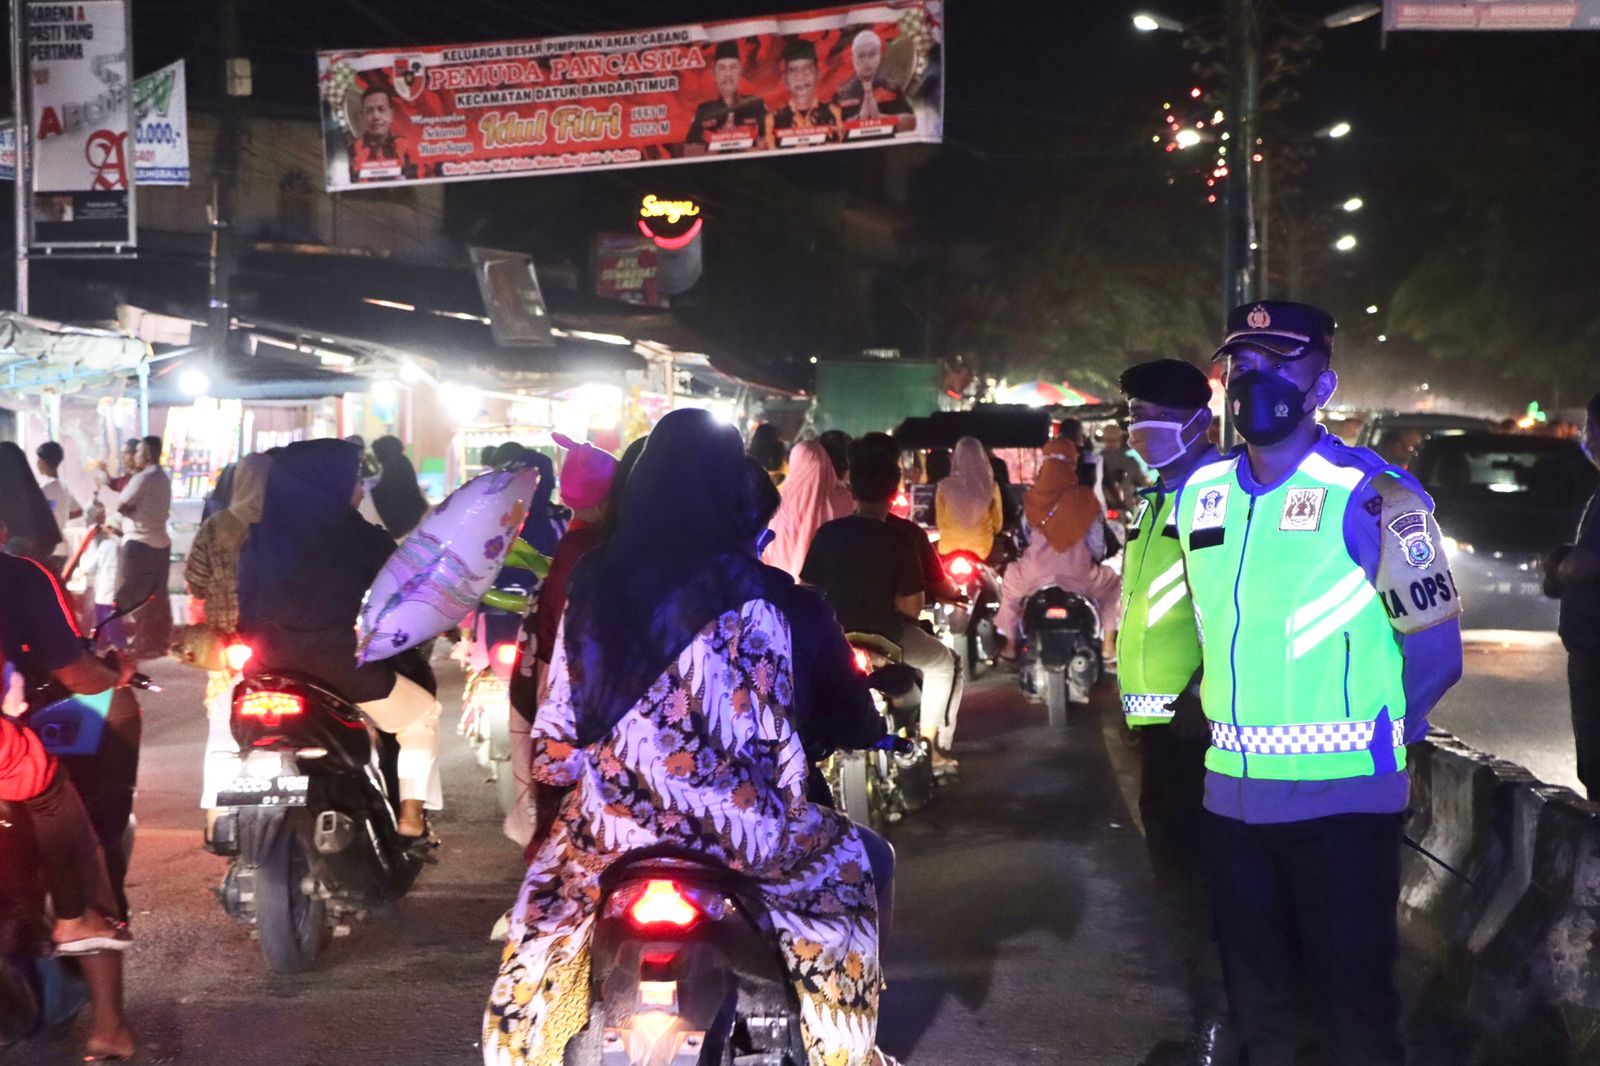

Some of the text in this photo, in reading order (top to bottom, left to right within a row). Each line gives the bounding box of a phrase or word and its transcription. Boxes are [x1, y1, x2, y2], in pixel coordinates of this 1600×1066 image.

[77, 6, 86, 21] A
[64, 24, 94, 40] YANG
[443, 30, 690, 62] KELUARGA BESAR PIMPINAN ANAK CABANG
[30, 43, 84, 60] PERTAMA
[428, 46, 707, 90] PEMUDA PANCASILA
[456, 76, 678, 107] KECAMATAN DATUK BANDAR TIMUR
[480, 103, 622, 149] Idul Fitri
[640, 194, 700, 224] Surya
[1410, 572, 1452, 611] OPS
